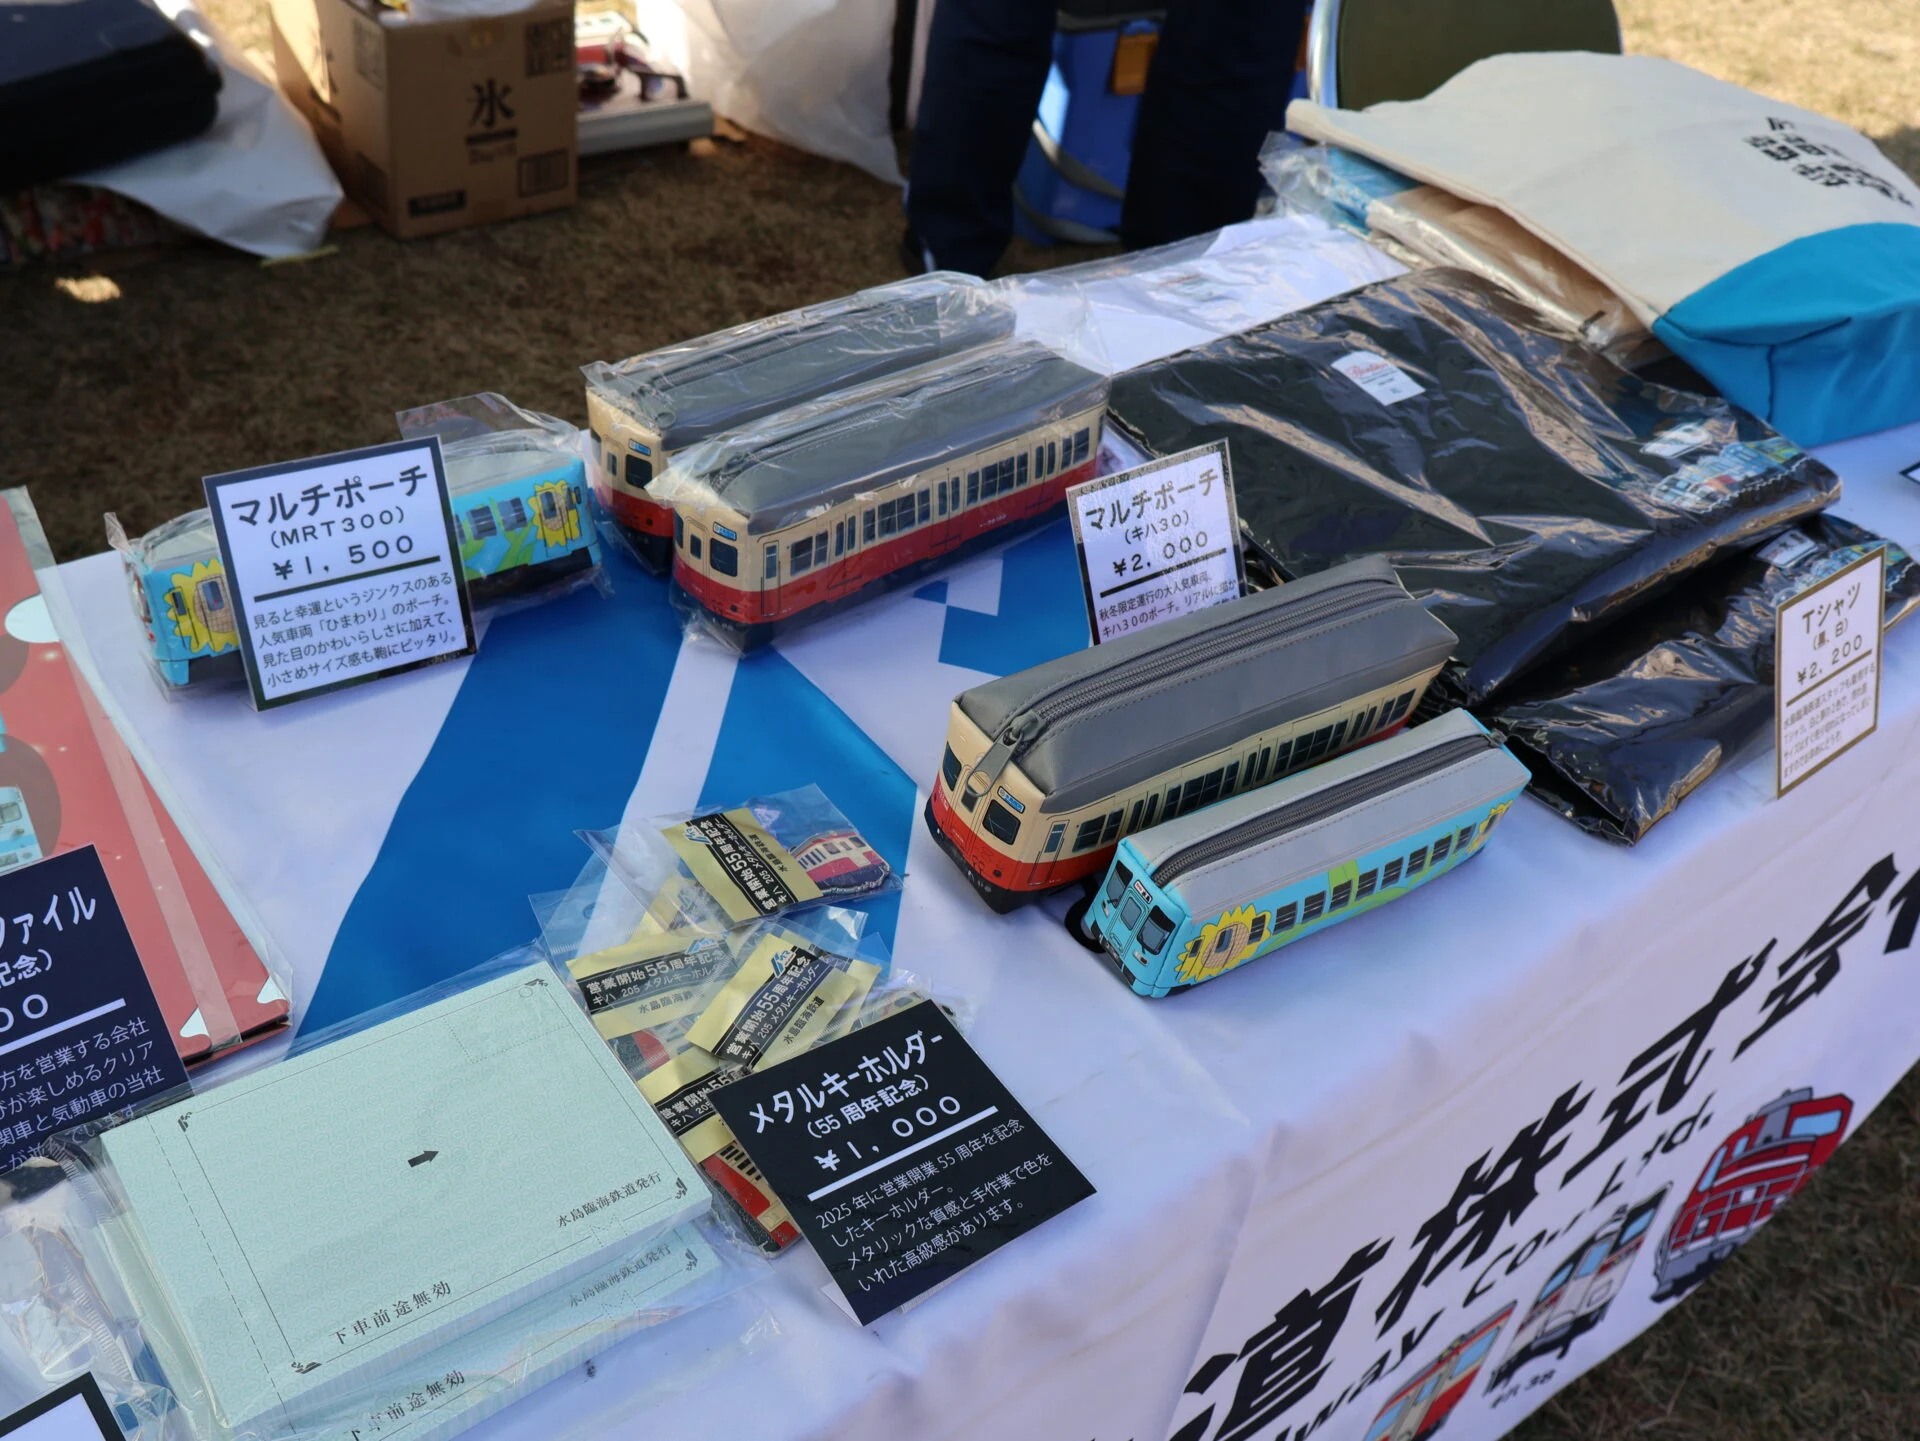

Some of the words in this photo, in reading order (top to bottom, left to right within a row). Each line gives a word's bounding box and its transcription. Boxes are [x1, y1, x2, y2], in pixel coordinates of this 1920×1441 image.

[231, 465, 428, 526] マルチポーチ
[1085, 468, 1218, 530] マルチポーチ
[270, 505, 405, 549] (MRT300)
[1124, 509, 1189, 545] (キハ30)
[272, 535, 414, 581] ¥1,500
[253, 571, 453, 630] 見ると幸運というジンクスのある
[258, 594, 450, 650] 人気車両「ひまわり」のポーチ。
[1802, 582, 1861, 634] Tシャツ
[262, 611, 454, 669] 見た目のかわいらしさに加えて、
[266, 633, 457, 689] 小さめサイズ感も鞄にピッタリ。
[700, 820, 778, 911] 営業開始55周年記念
[758, 869, 775, 885] 205
[621, 985, 641, 998] 205
[726, 955, 811, 1056] 営業開始55周年記念
[757, 1023, 774, 1039] 205
[770, 963, 820, 1024] メタルキーホルダー
[0, 1017, 149, 1092] 方を営業する会社
[748, 1030, 944, 1134] メタルキーホルダー
[813, 1094, 961, 1173] ¥1,000
[1168, 852, 1920, 1441] 道株式会
[556, 1170, 662, 1228] 水島臨海鉄道発行
[830, 1183, 954, 1249] したキーホルダー。
[846, 1151, 1053, 1270] メタリックな質感と手作業で色を
[858, 1201, 1025, 1292] いれた高級感があります。
[330, 1281, 451, 1345] 下車前途無効
